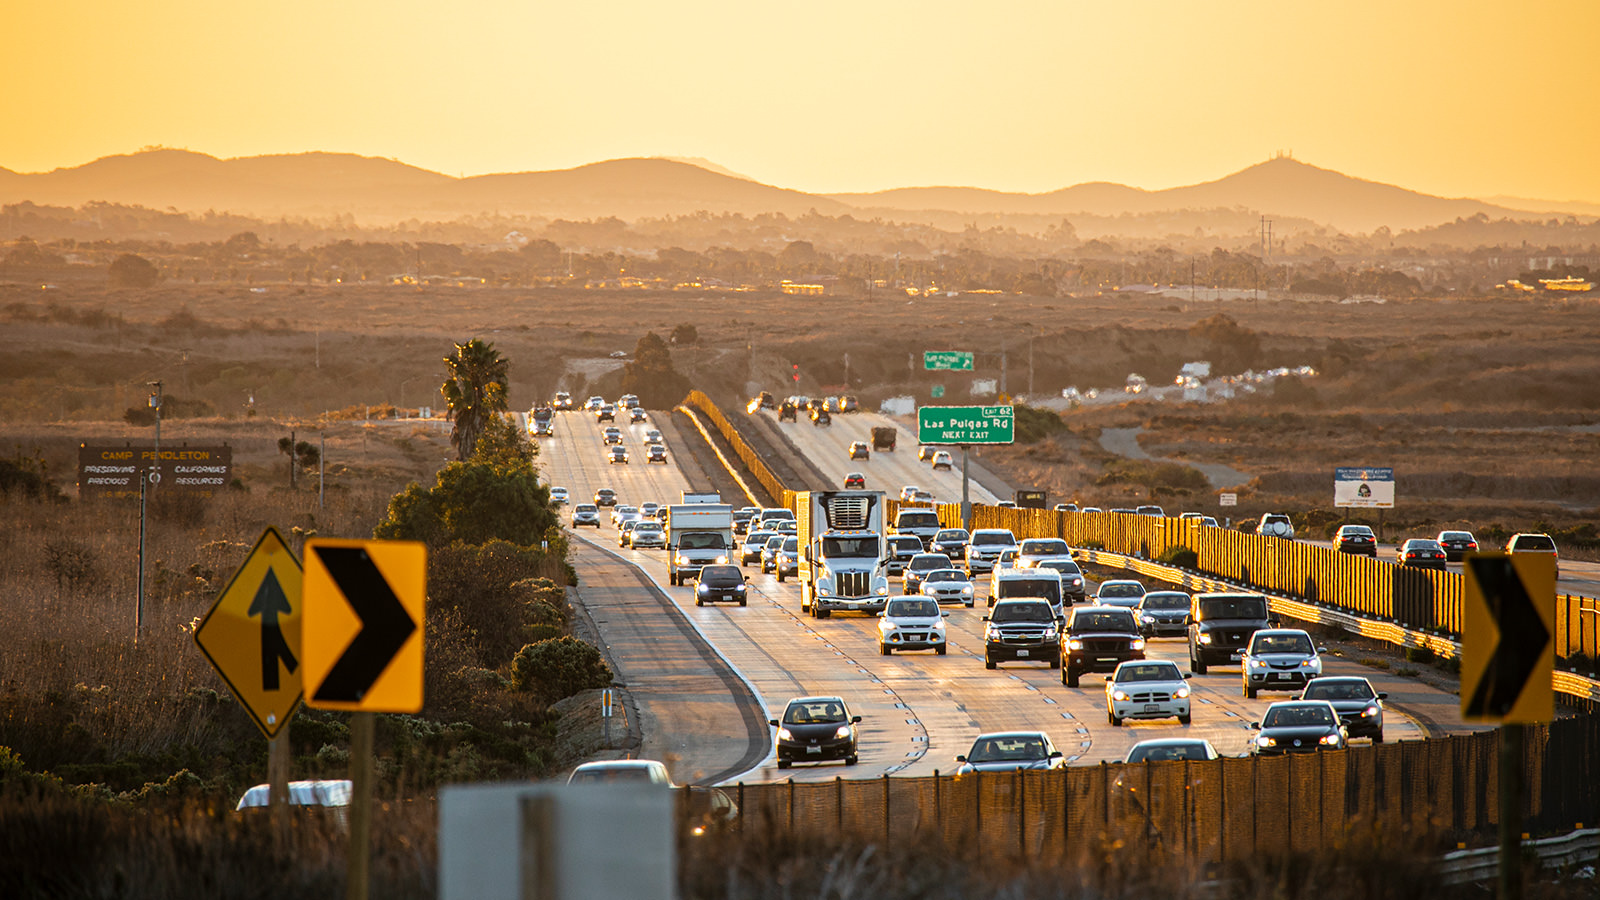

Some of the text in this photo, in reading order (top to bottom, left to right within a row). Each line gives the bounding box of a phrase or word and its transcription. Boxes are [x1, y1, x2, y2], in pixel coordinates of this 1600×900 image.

[924, 418, 1008, 430] Las Pulgas Rd
[942, 431, 989, 439] NEXT EXIT
[101, 451, 210, 460] CAMP PENDLETON
[84, 465, 136, 474] PRESERVING
[87, 477, 224, 485] PRECIOUS RESOURCES
